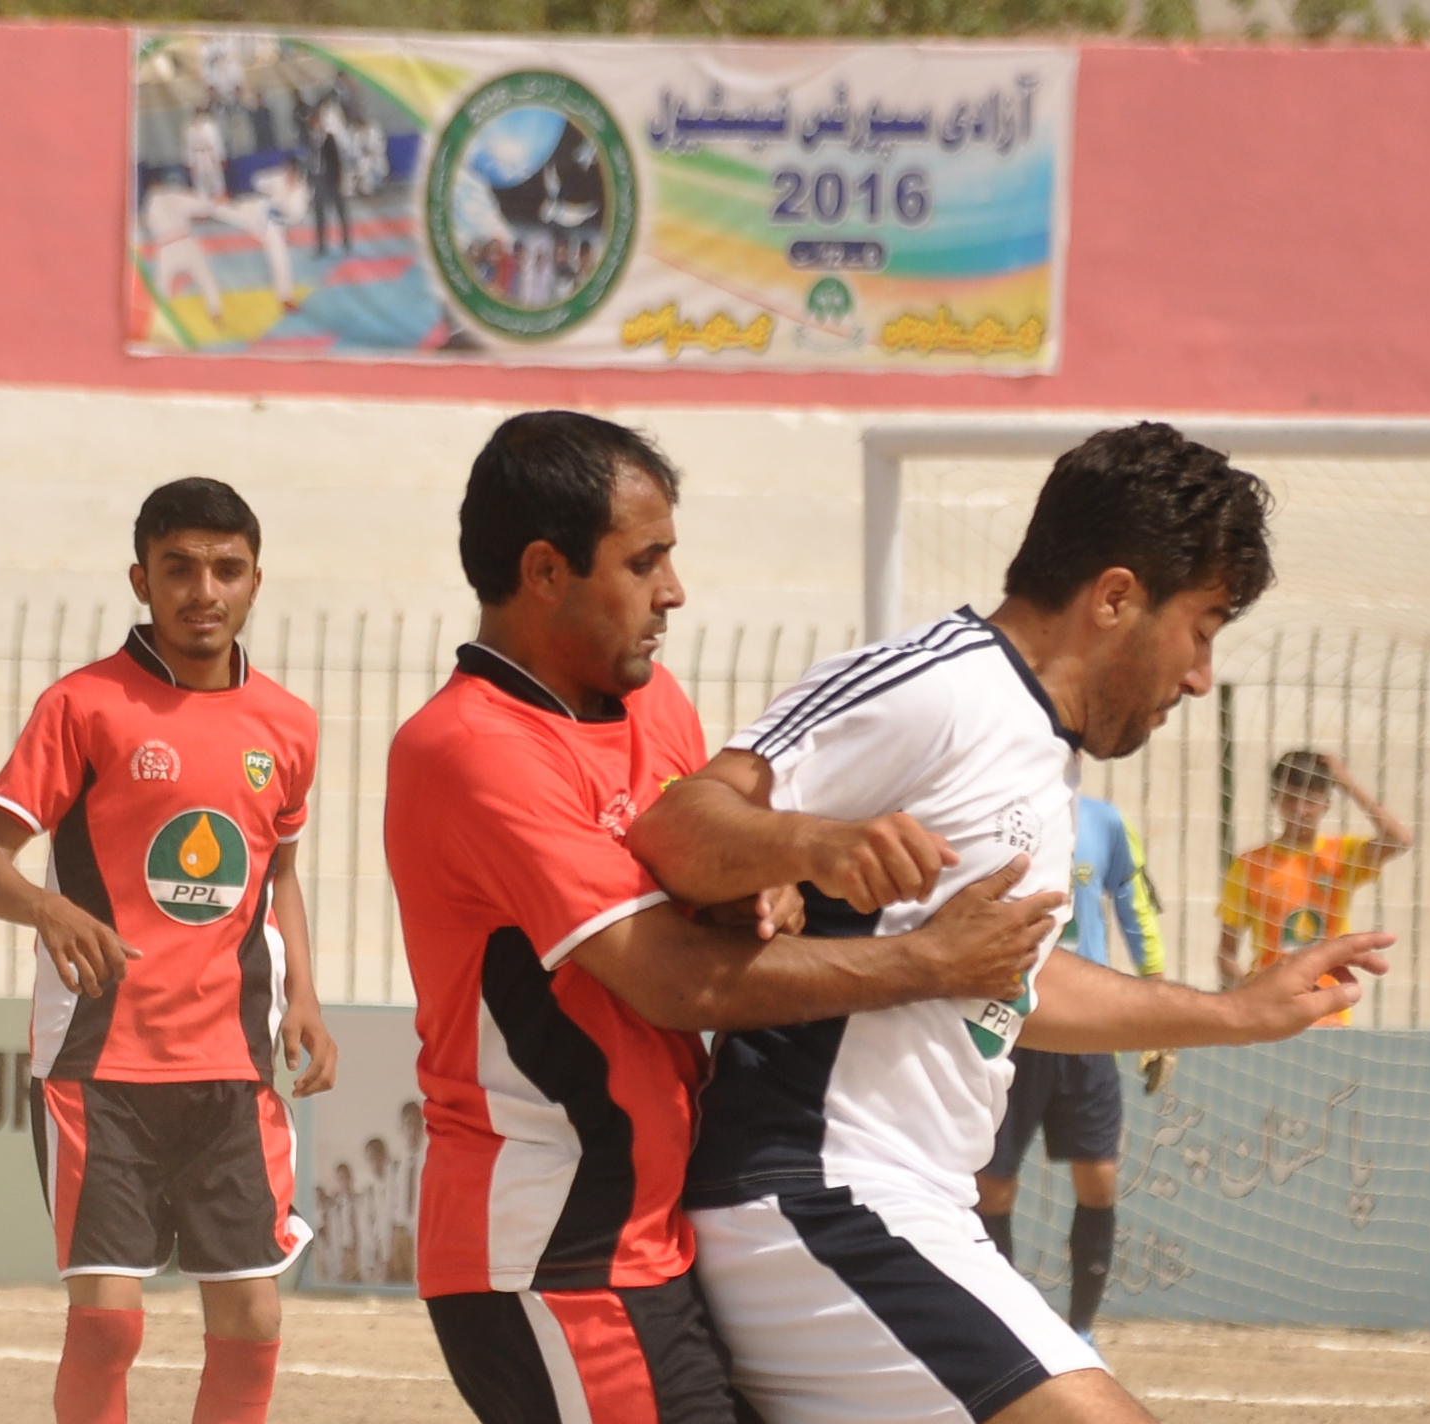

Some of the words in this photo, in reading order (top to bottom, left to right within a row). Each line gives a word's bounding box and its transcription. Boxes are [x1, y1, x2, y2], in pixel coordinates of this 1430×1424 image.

[772, 171, 930, 228] 2016
[247, 755, 271, 770] PFF
[142, 770, 168, 781] BFA
[172, 885, 221, 904] PPL
